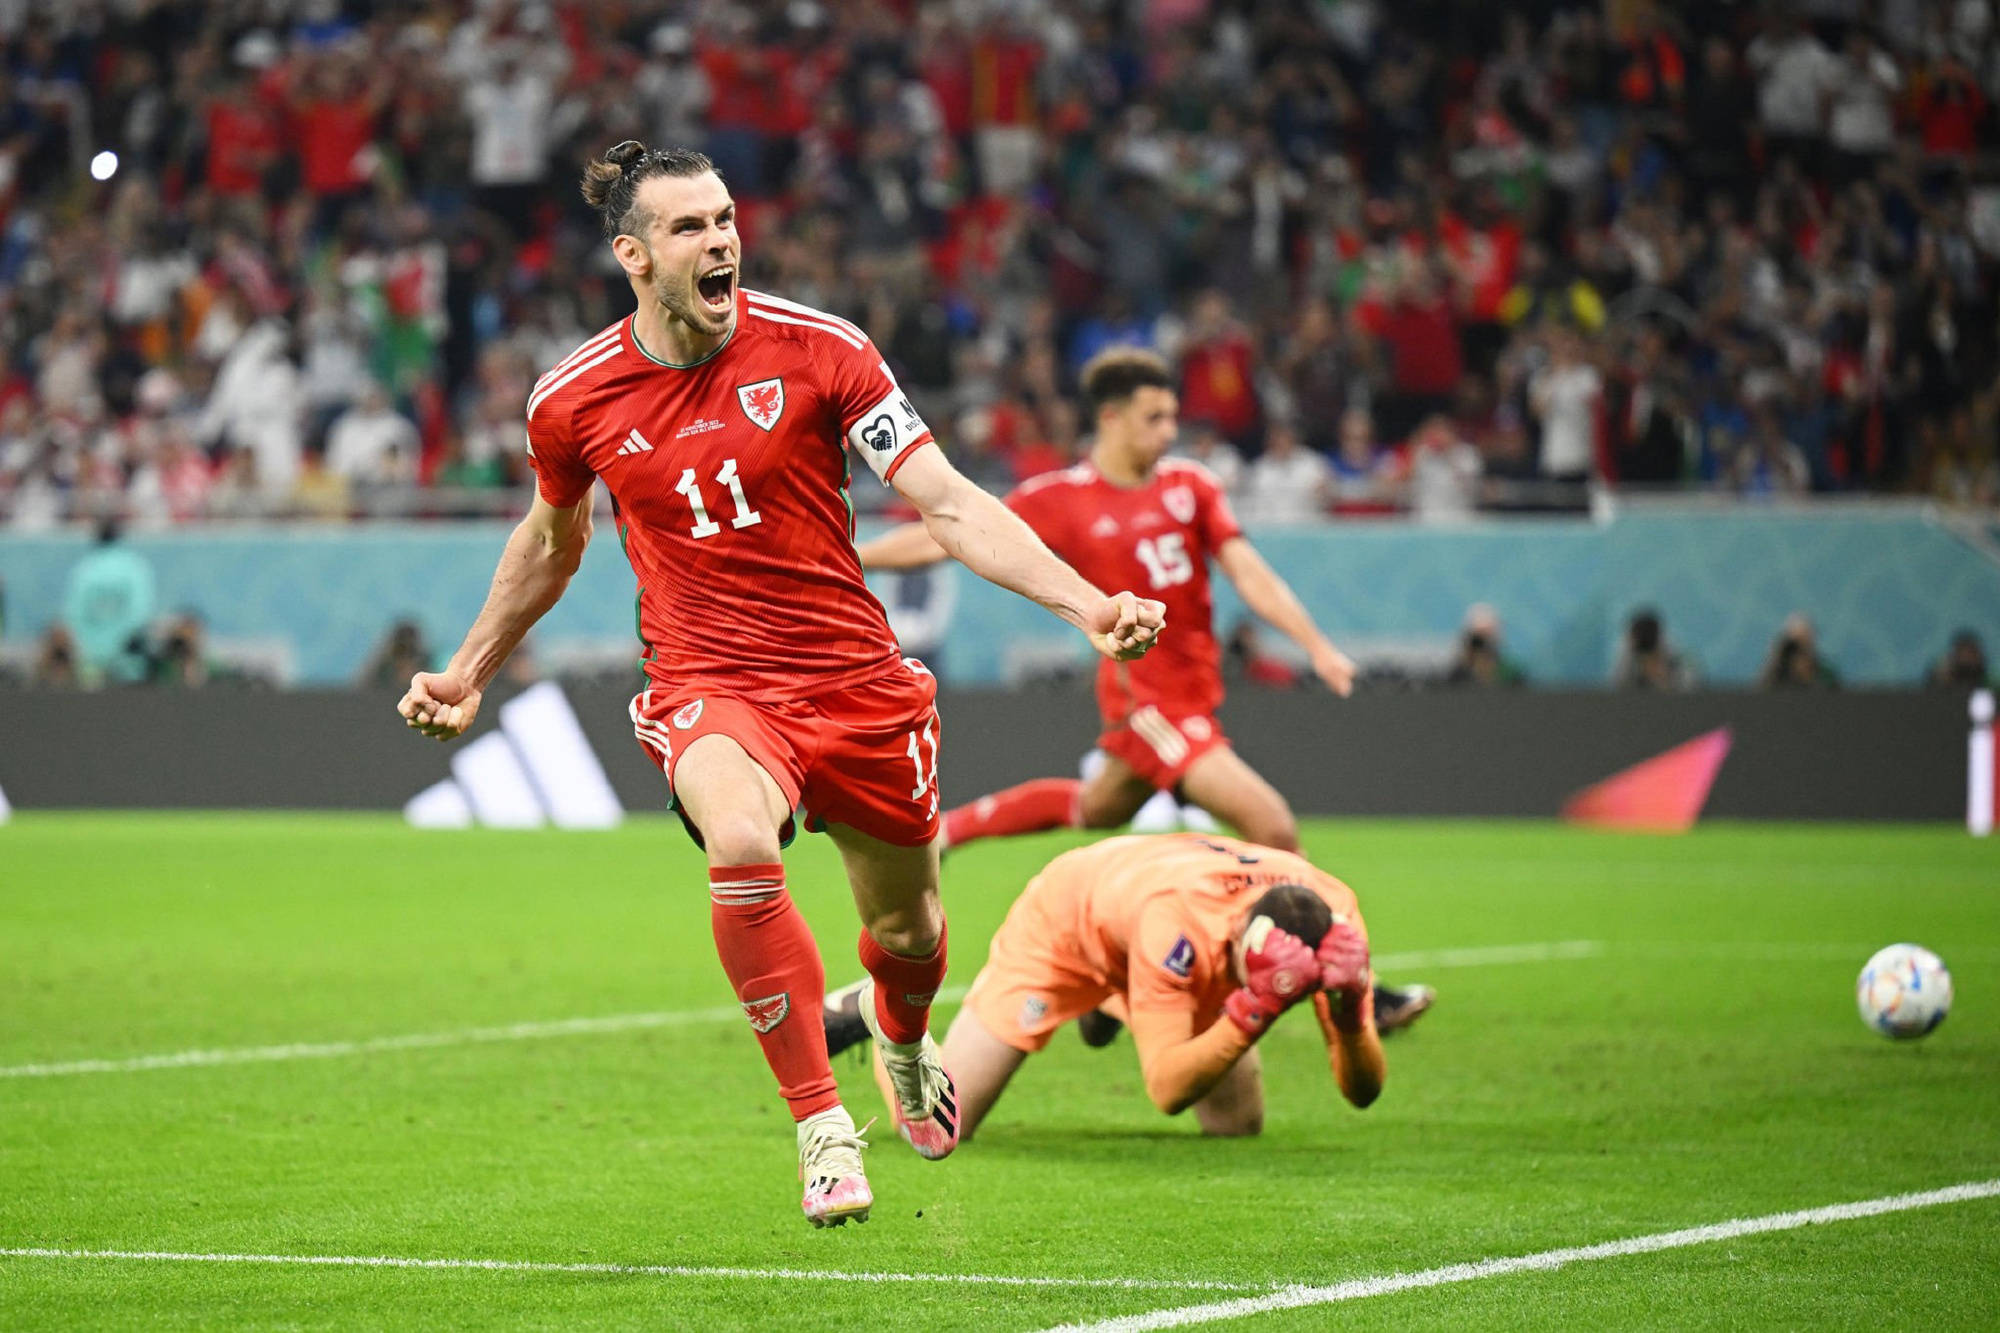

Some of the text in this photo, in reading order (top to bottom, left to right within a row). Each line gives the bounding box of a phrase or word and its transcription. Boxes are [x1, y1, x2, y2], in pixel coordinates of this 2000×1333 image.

[674, 458, 762, 540] 11
[1135, 531, 1195, 592] 15
[906, 714, 938, 801] 11
